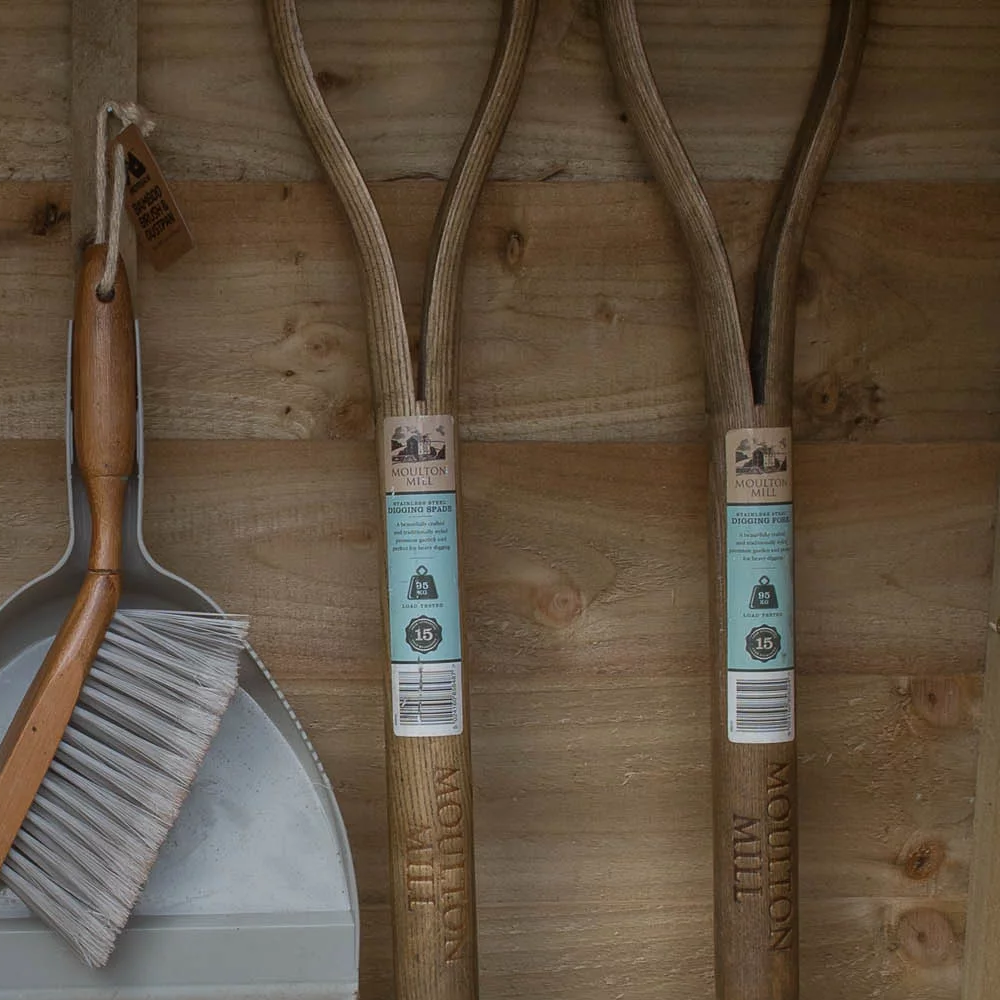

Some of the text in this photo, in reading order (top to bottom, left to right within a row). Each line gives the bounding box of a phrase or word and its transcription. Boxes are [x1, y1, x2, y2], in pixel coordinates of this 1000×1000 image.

[391, 466, 447, 478] MOULTON
[406, 476, 433, 487] MILL
[735, 478, 787, 489] MOULTON
[751, 487, 777, 497] MILL
[388, 505, 453, 514] DIGGING SPADE
[731, 517, 770, 525] DIGGING
[757, 591, 771, 600] 95
[414, 627, 434, 641] 15
[755, 637, 774, 650] 15
[732, 813, 763, 903] MILL
[766, 763, 793, 951] MOULTON
[406, 825, 436, 912] MILL
[434, 767, 468, 965] MOULTON
